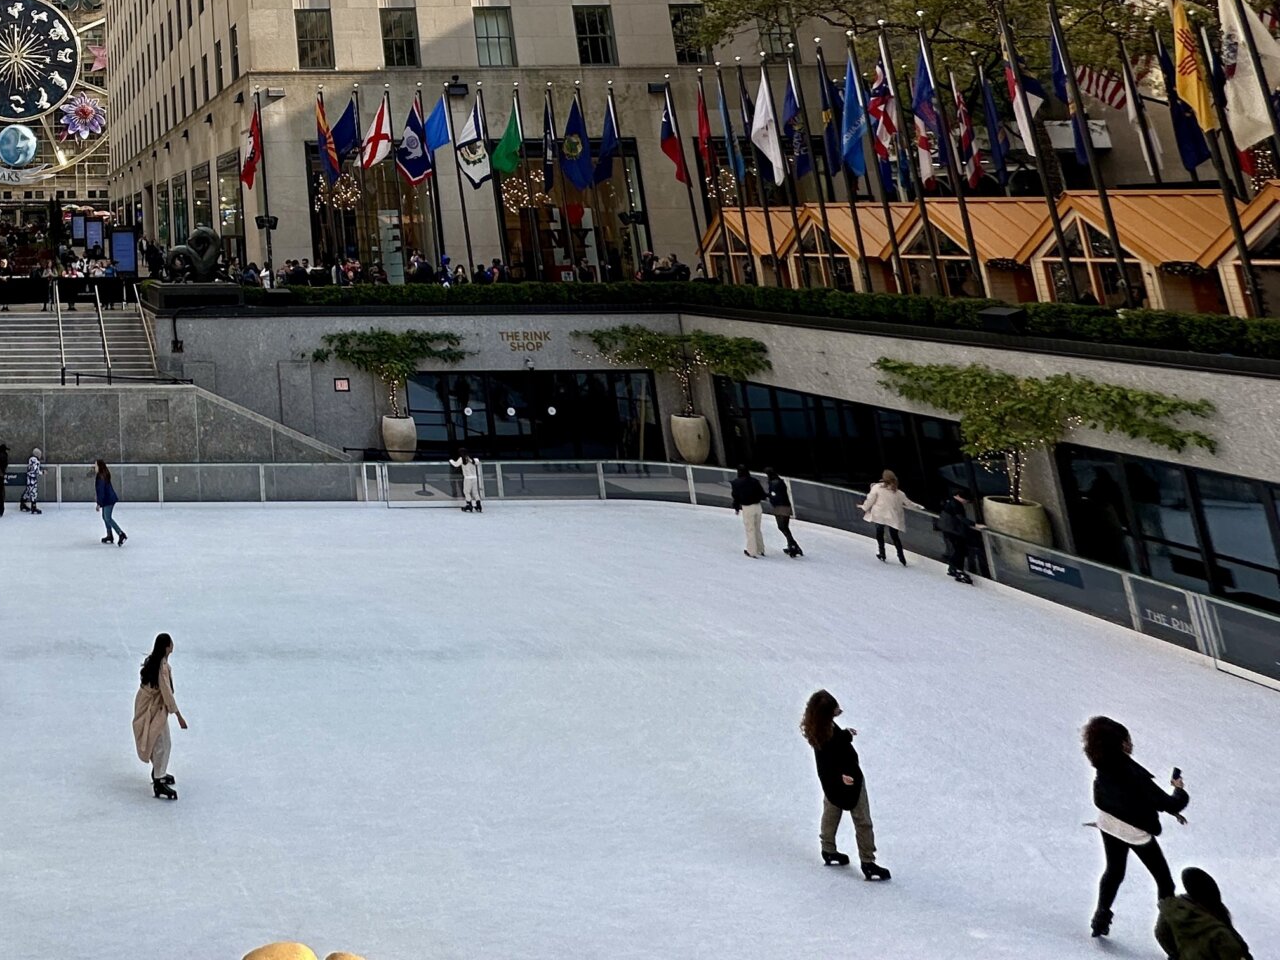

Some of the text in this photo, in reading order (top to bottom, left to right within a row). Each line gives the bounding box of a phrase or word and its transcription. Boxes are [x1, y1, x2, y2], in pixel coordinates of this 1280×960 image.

[499, 331, 552, 341] THE RINK
[510, 342, 543, 352] SHOP
[1145, 608, 1193, 633] THE RIN
